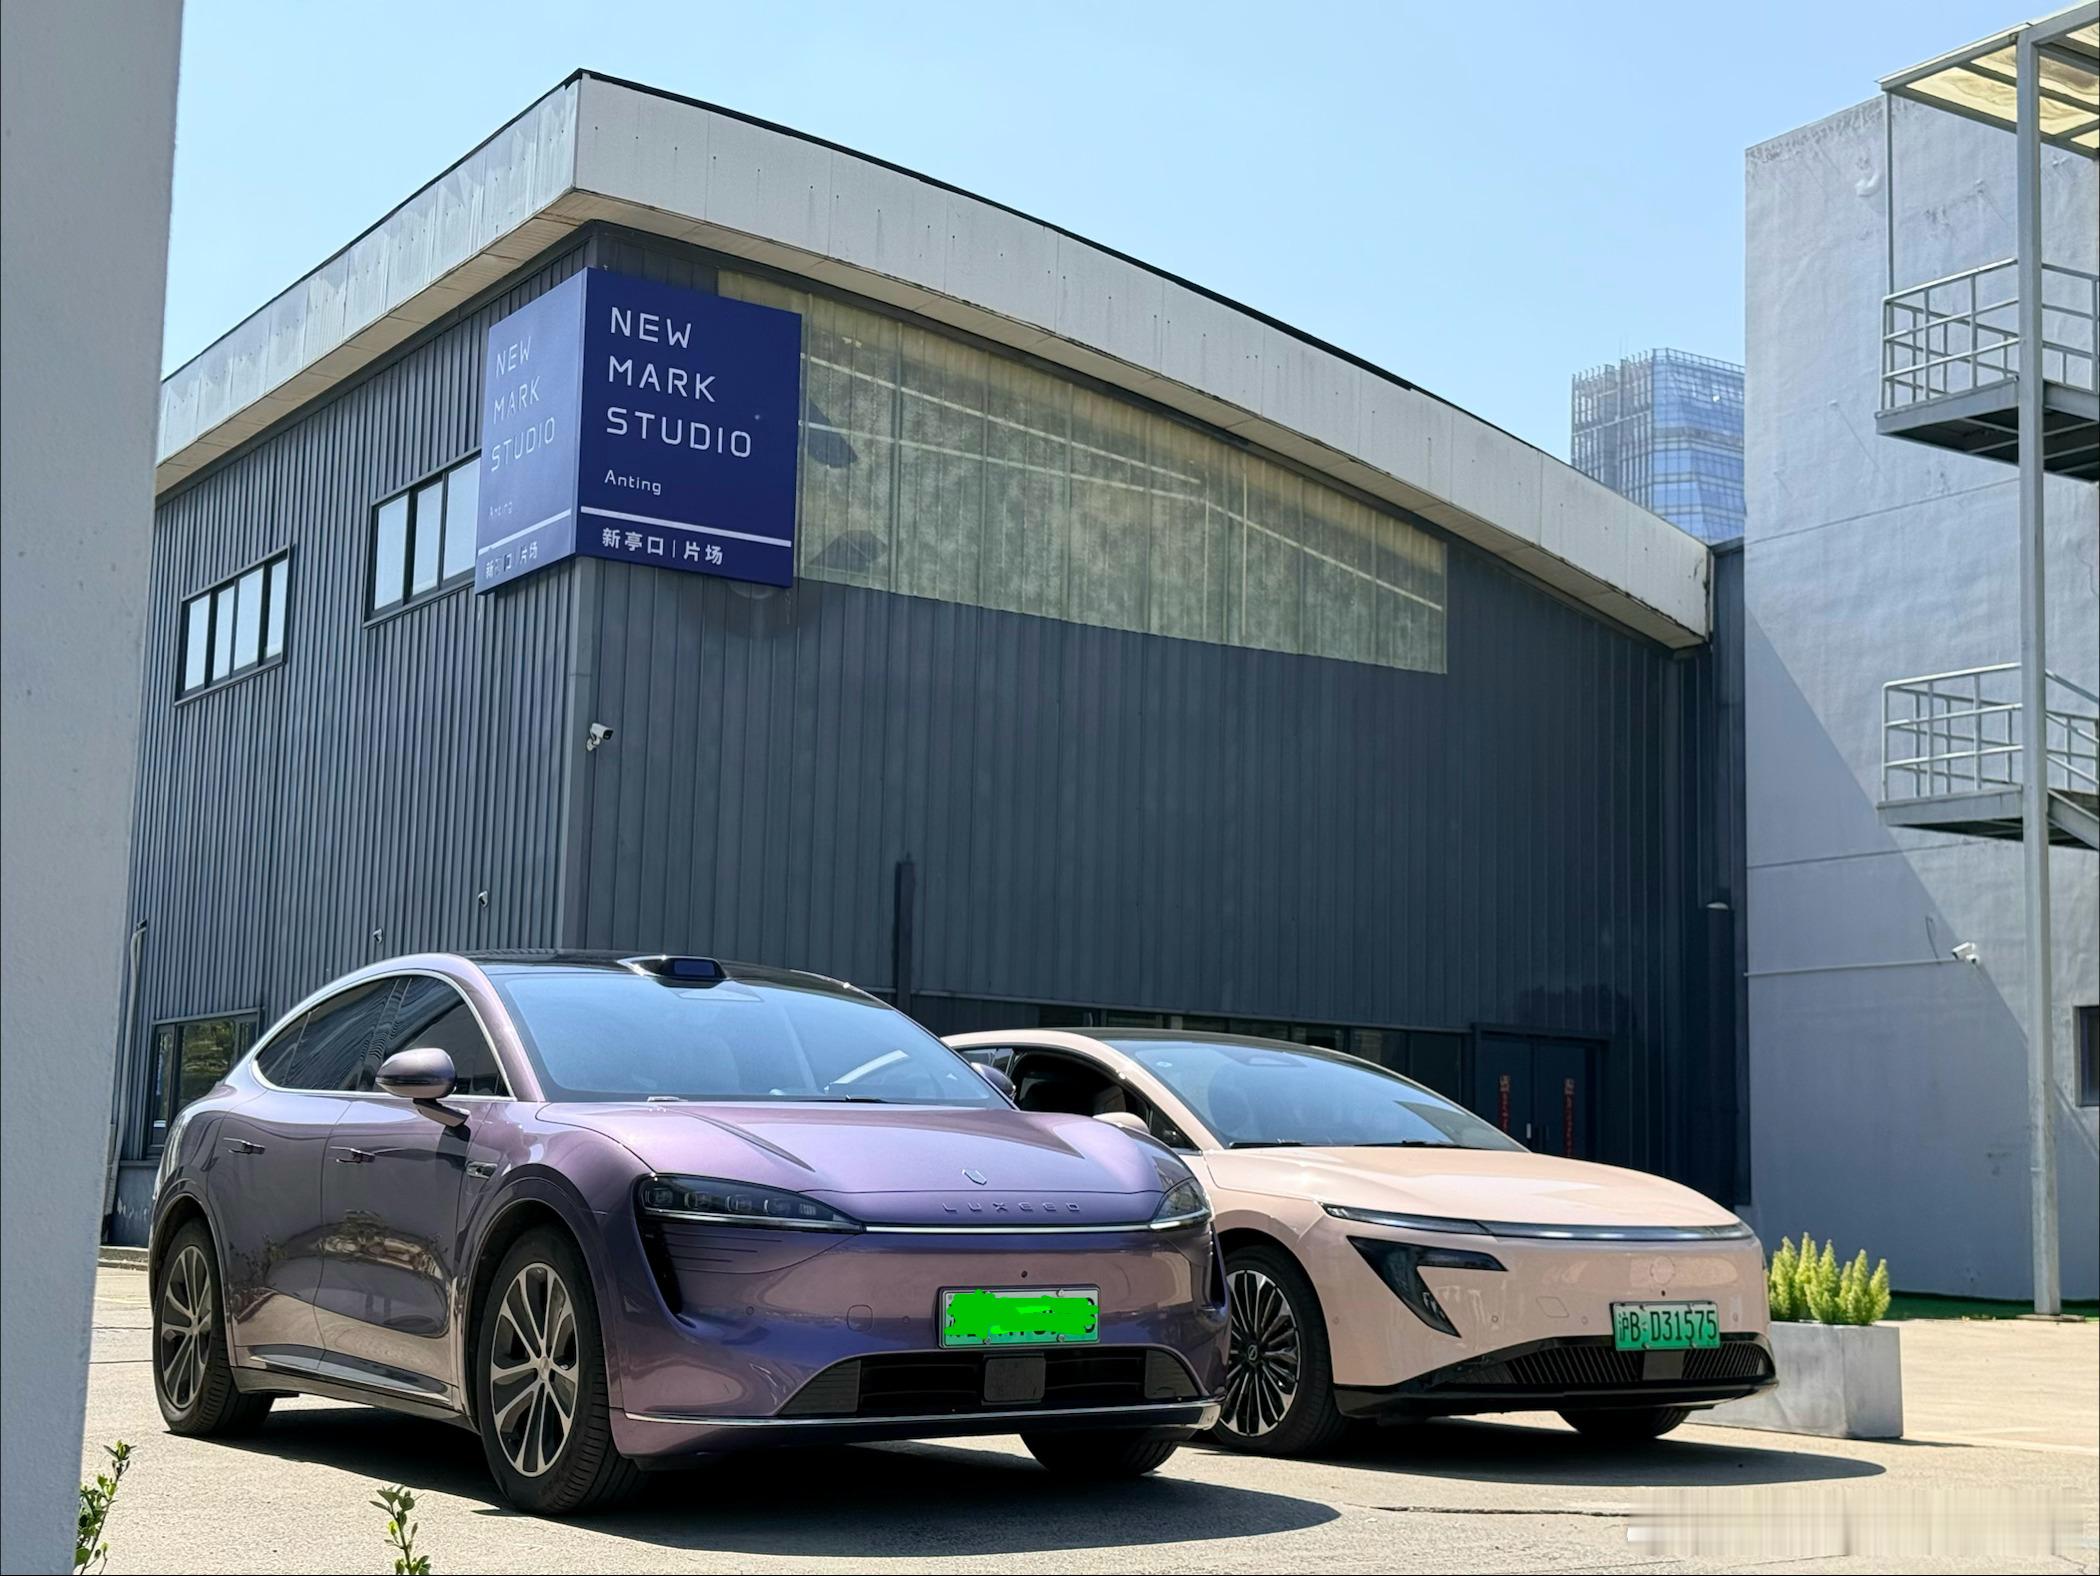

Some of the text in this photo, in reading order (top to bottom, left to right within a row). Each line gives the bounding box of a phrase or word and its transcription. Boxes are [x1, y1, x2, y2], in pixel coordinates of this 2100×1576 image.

[609, 306, 692, 349] NEW
[495, 335, 532, 378] NEW
[493, 375, 540, 425] MARK
[608, 355, 716, 402] MARK
[490, 416, 556, 473] STUDIO
[606, 406, 752, 458] STUDIO
[604, 469, 662, 496] Anting
[485, 552, 512, 580] 新口
[602, 527, 724, 565] 新亭口 片场
[942, 1201, 1081, 1213] LUXEED
